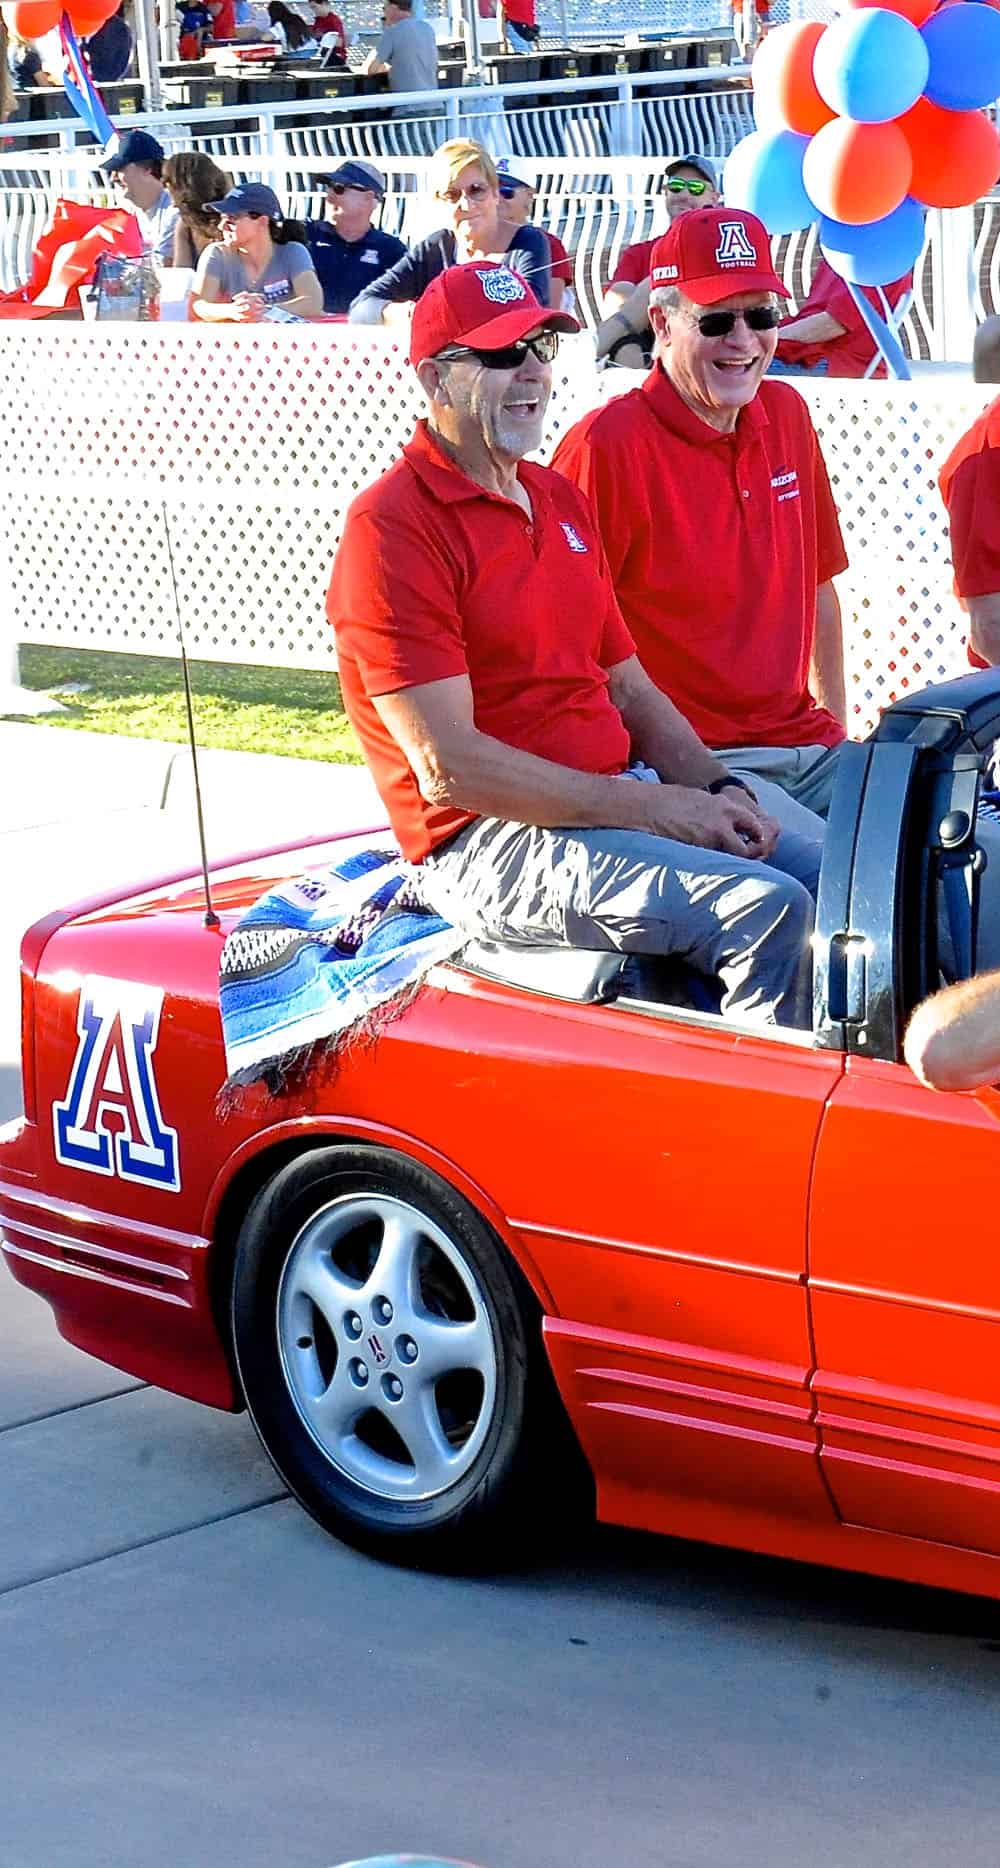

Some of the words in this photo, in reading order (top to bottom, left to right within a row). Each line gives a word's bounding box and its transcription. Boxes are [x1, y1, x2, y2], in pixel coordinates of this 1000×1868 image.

[715, 221, 757, 262] A
[720, 261, 757, 269] FOOTBALL
[559, 521, 588, 553] A
[52, 973, 181, 1193] A
